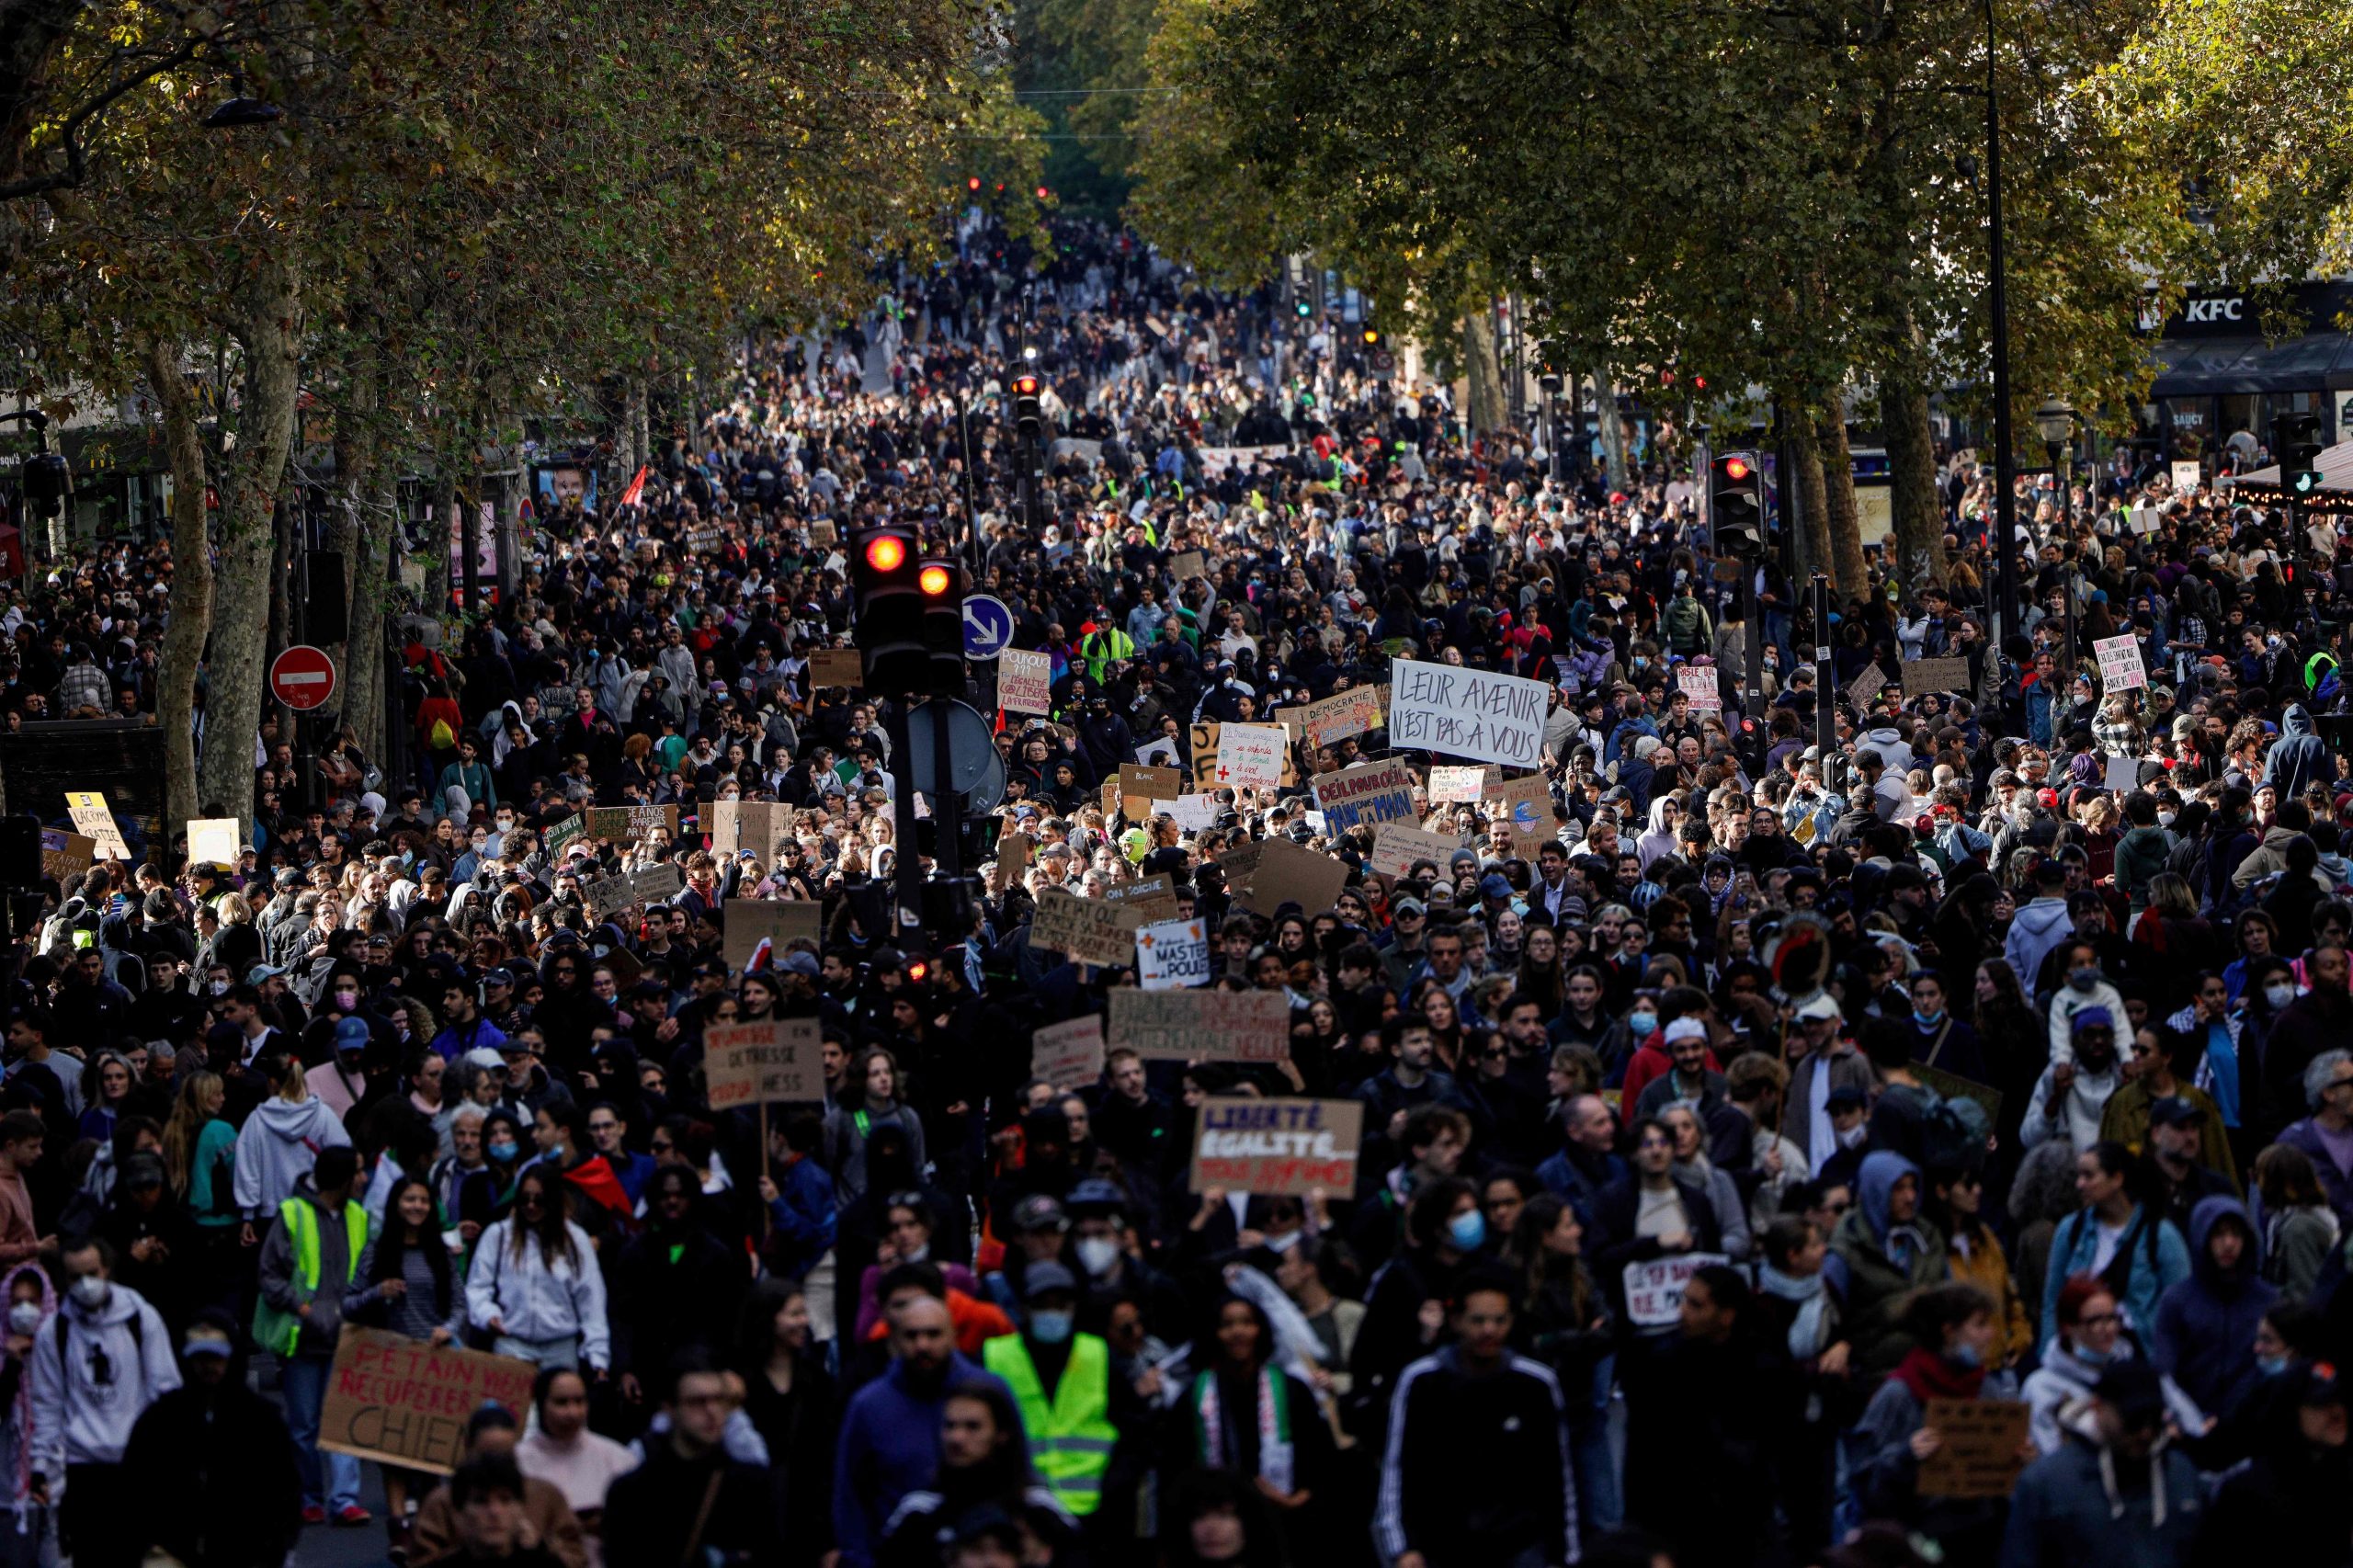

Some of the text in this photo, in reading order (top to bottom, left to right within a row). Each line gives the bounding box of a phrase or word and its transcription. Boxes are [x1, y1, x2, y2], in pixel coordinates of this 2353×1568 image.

[2186, 298, 2244, 322] KFC
[2173, 414, 2204, 426] SAUCY
[1002, 649, 1051, 670] POURQUOI
[1400, 667, 1455, 709] LEUR
[1461, 677, 1541, 731] AVENIR
[1393, 709, 1434, 741] N'EST
[1436, 717, 1464, 746] PAS
[1467, 714, 1484, 751] À
[1490, 722, 1536, 763] VOUS
[1135, 772, 1154, 781] BLANC
[1317, 764, 1409, 803] OEIL POUR OEIL
[648, 807, 665, 817] NOS
[1360, 811, 1376, 825] LA
[1372, 789, 1413, 823] MAIN
[719, 810, 769, 830] MAMAN
[549, 827, 559, 838] QUI
[1106, 888, 1124, 900] ON
[355, 1340, 476, 1383] PÉTAIN
